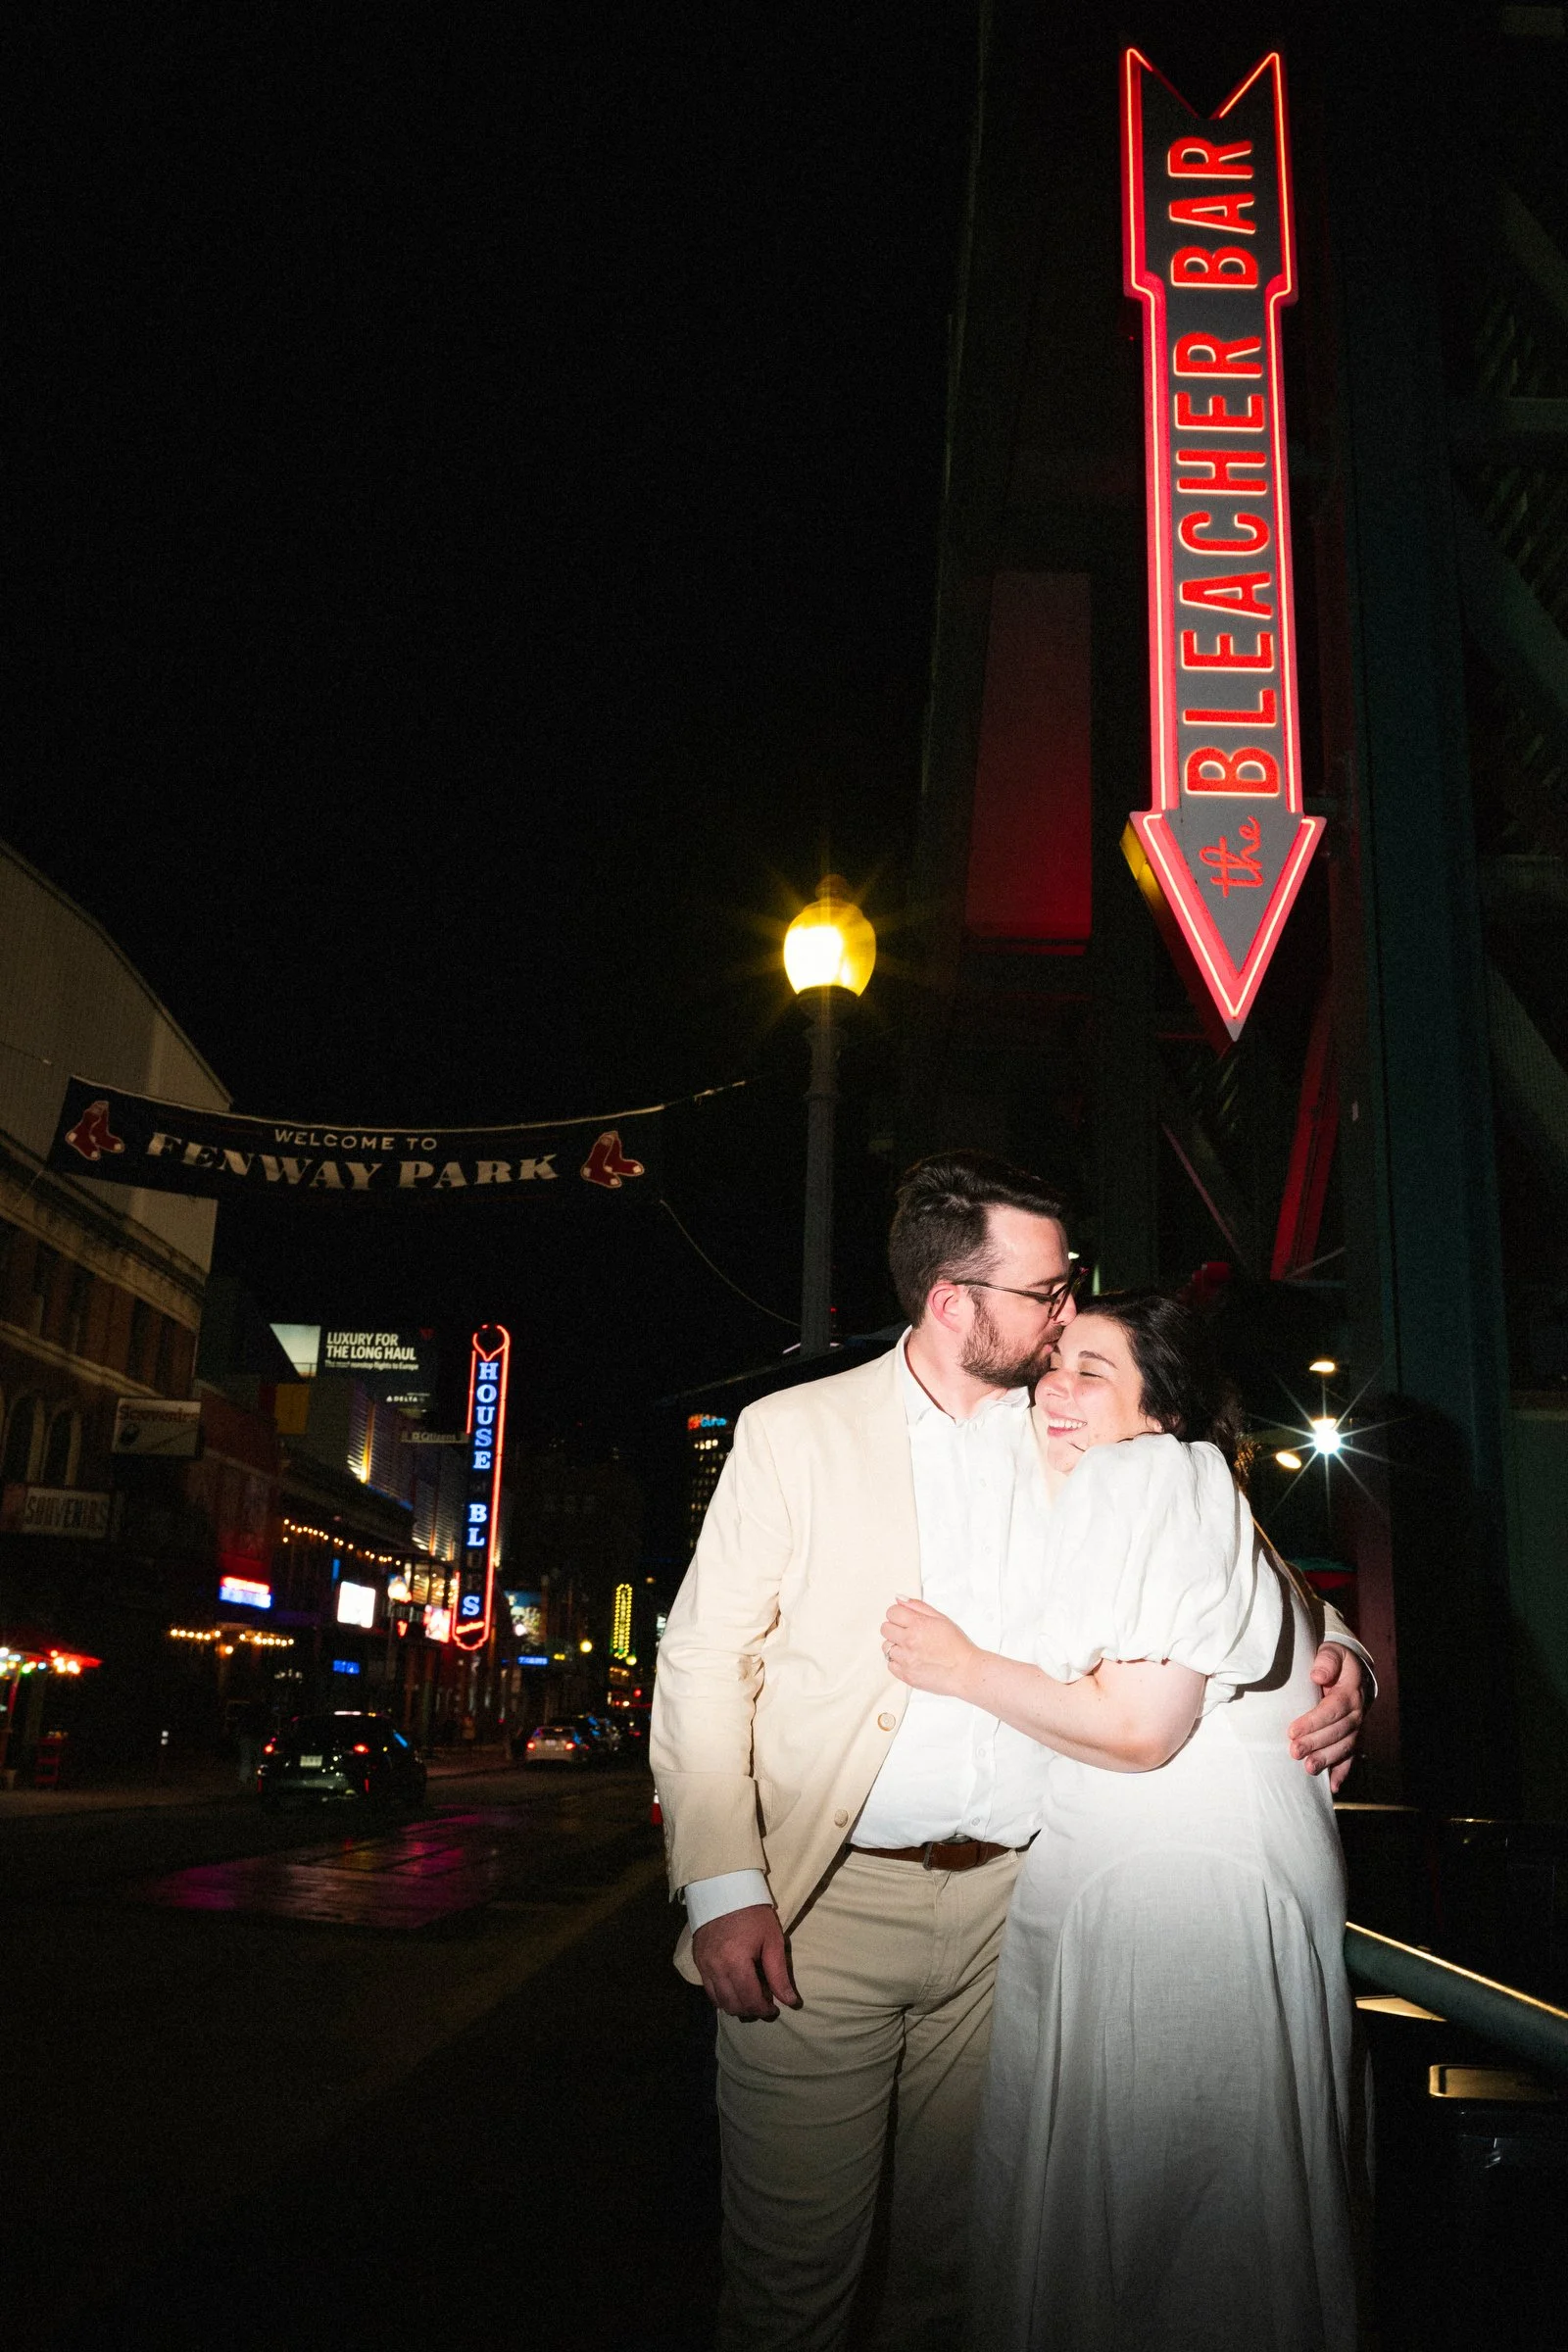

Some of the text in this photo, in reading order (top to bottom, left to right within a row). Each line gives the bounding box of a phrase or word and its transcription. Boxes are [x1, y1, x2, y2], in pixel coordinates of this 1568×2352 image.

[1167, 136, 1280, 906] the BLEACHER BAR
[273, 1128, 438, 1151] WELCOME TO
[145, 1132, 560, 1191] FENWAY PARK
[326, 1332, 399, 1347] LUXURY FOR
[326, 1345, 416, 1361] THE LONG HAUL
[471, 1361, 500, 1470] HOUSE
